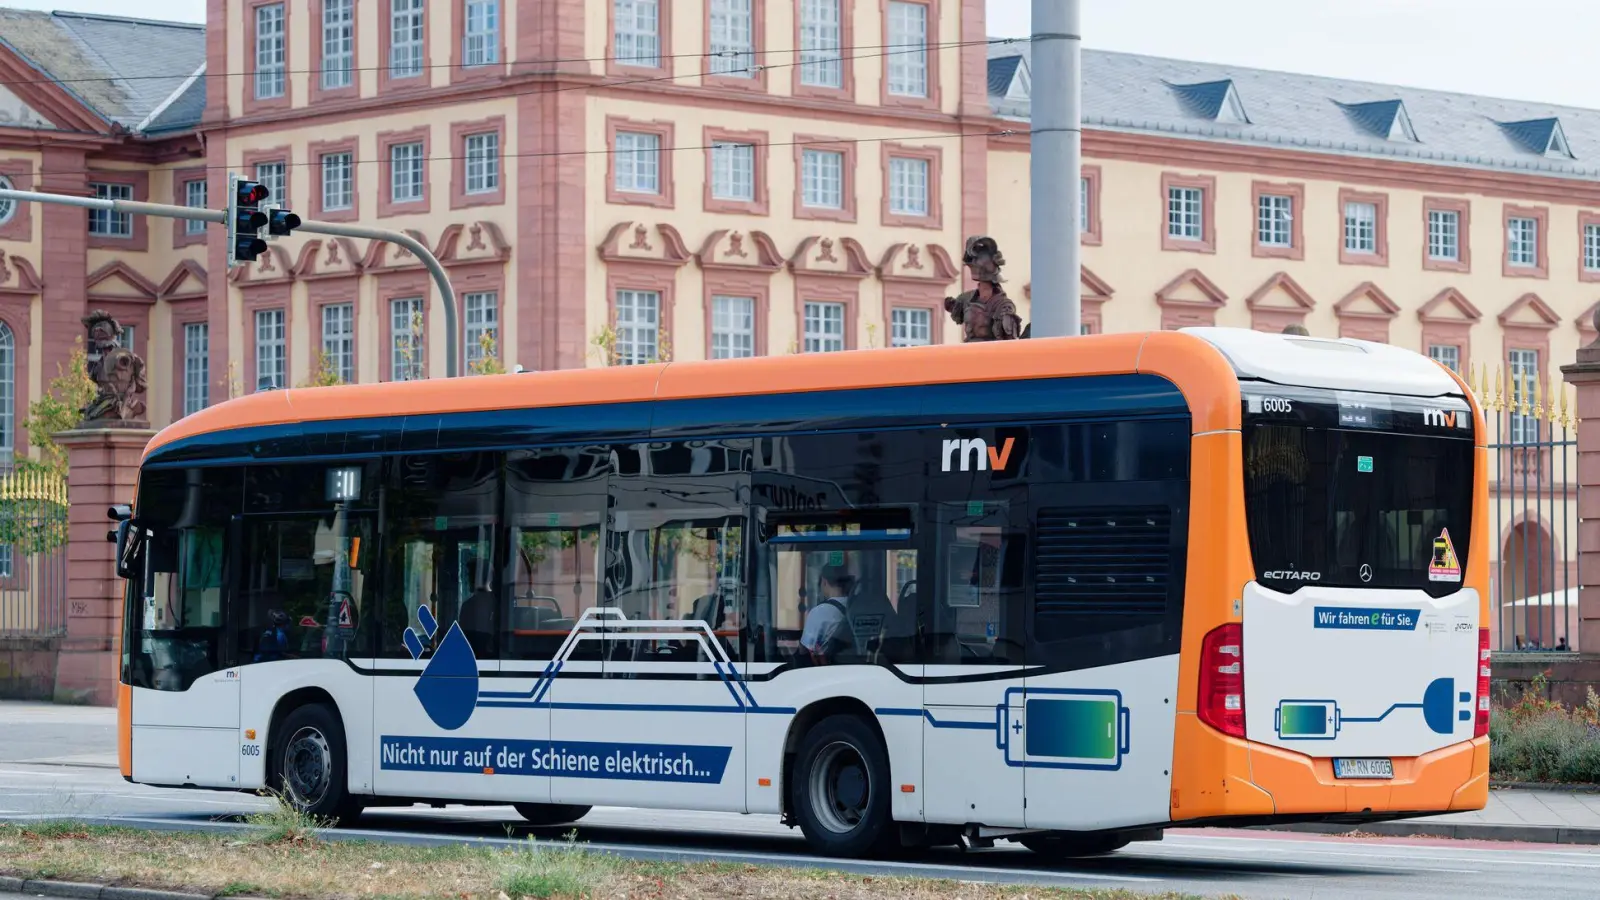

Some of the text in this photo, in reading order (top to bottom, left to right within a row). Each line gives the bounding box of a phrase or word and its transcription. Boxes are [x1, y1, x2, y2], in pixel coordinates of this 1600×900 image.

[1264, 398, 1292, 412] 6005
[941, 437, 1015, 472] rnv
[1263, 570, 1321, 580] eCITARO
[1318, 612, 1336, 624] Wir
[1338, 612, 1370, 625] fahren
[1371, 612, 1380, 627] e
[1381, 613, 1395, 625] für
[1397, 614, 1413, 626] Sie.
[242, 745, 260, 756] 6005
[384, 743, 711, 777] Nicht nur auf der Schiene elektrisch...
[1340, 760, 1392, 774] MA RN 6005
